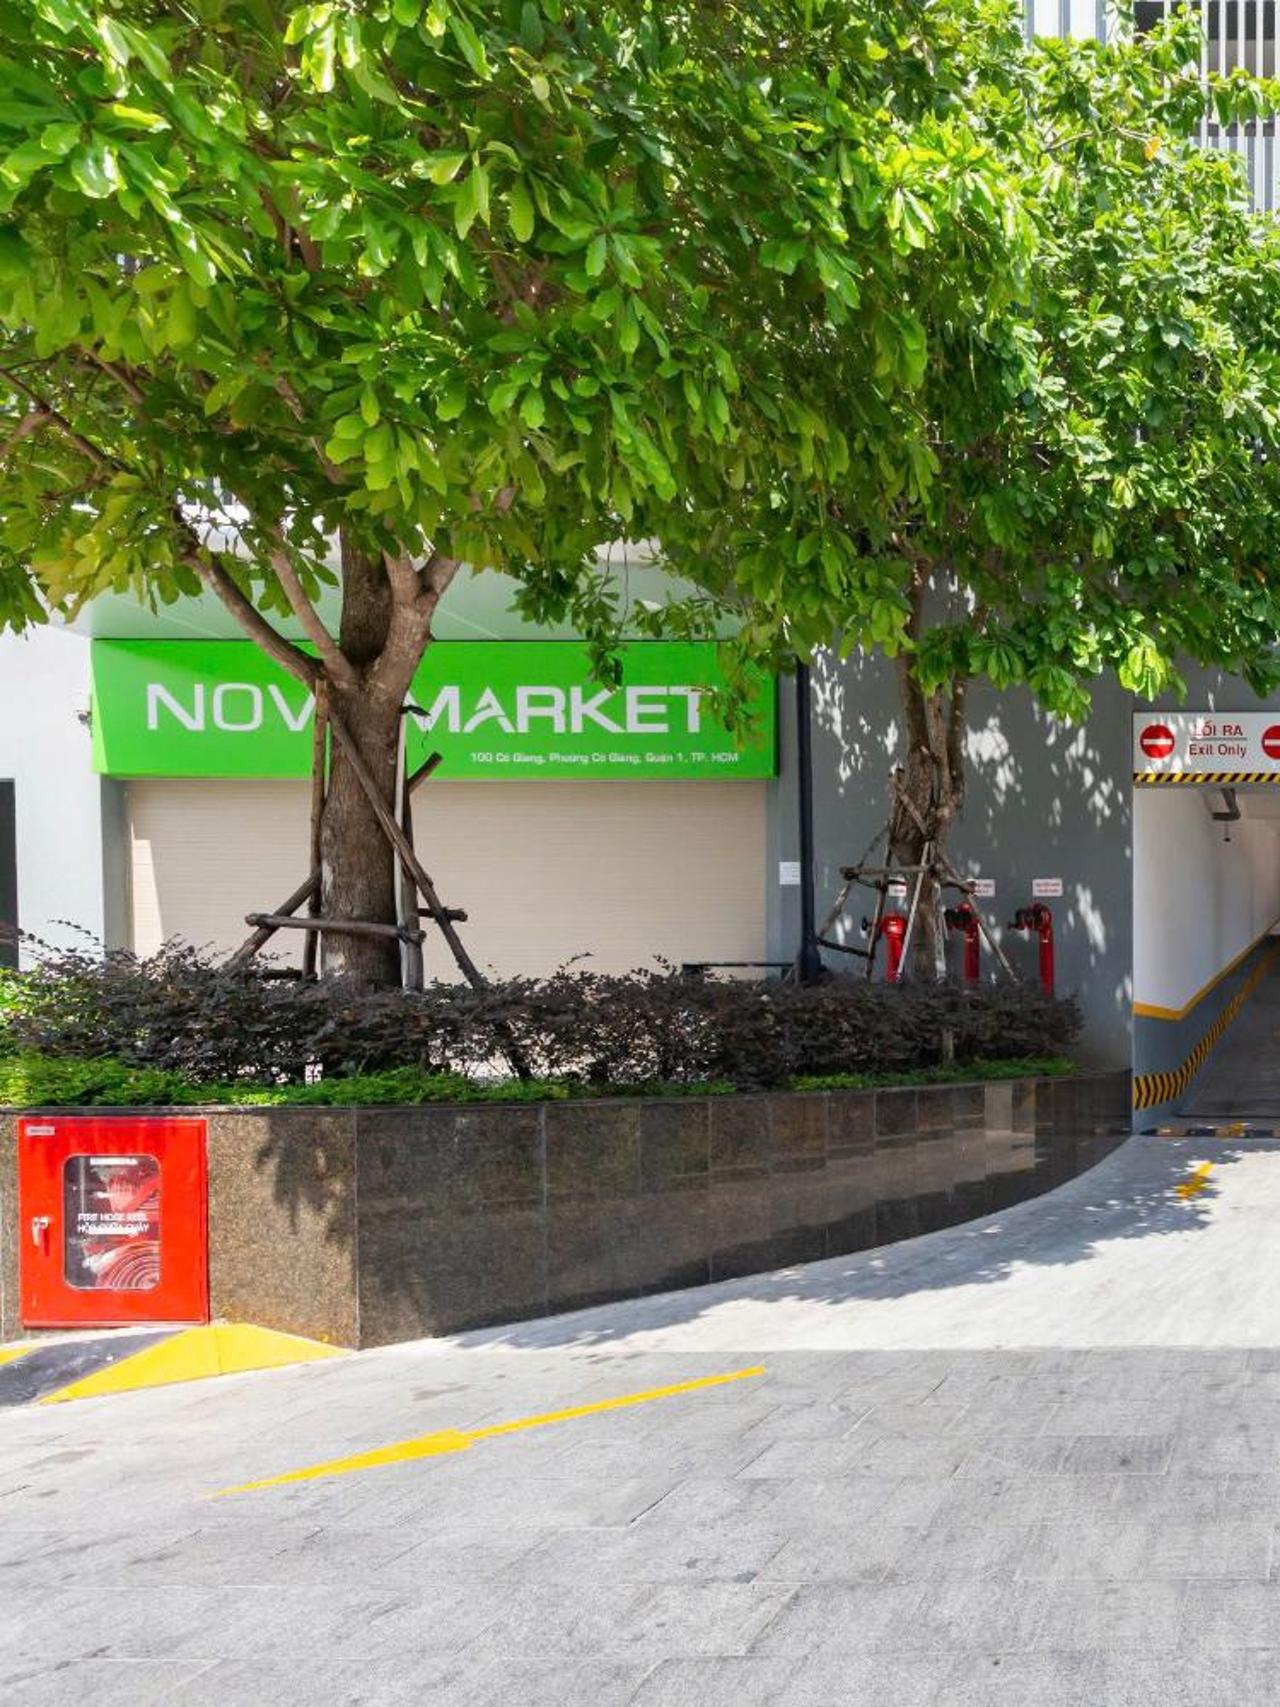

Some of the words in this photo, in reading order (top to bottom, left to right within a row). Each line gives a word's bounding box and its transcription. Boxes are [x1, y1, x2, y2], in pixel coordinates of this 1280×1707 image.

[147, 683, 316, 731] NOV
[403, 684, 713, 733] MARKET
[1223, 725, 1243, 736] RA
[471, 752, 492, 762] 100
[711, 752, 738, 762] HCM
[1189, 744, 1213, 755] Exit
[1218, 744, 1247, 759] Only
